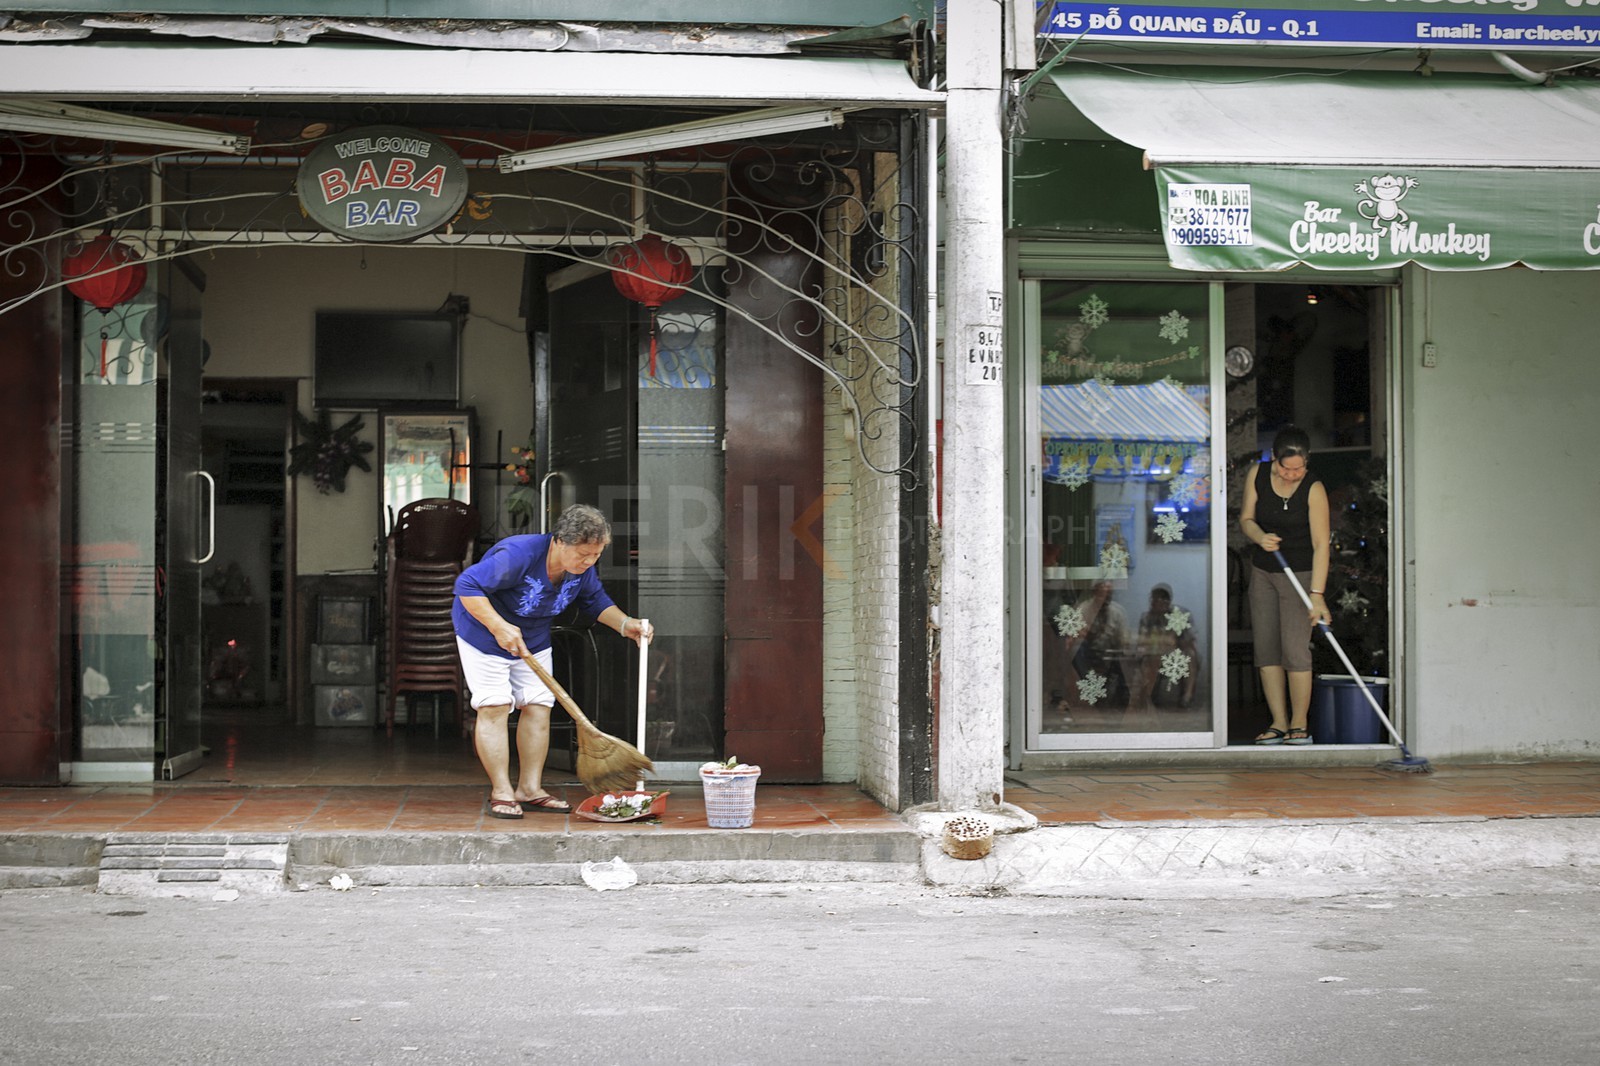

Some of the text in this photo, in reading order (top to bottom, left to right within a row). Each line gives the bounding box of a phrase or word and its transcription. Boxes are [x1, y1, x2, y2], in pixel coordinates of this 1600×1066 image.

[1051, 12, 1082, 28] 45
[1089, 7, 1122, 30] ĐỖ
[1129, 15, 1207, 33] QUANG
[1213, 11, 1261, 35] ĐẨU
[1282, 19, 1319, 38] Q.1
[1417, 22, 1600, 44] Email: barcheeky
[335, 136, 431, 159] WELCOME
[318, 157, 447, 205] BABA
[1222, 189, 1249, 206] BINH
[345, 199, 421, 229] BAR
[1189, 208, 1249, 226] 38727677
[1304, 200, 1342, 223] Bar
[1172, 228, 1249, 244] 0909595417
[1289, 220, 1491, 261] Cheeky Monkey
